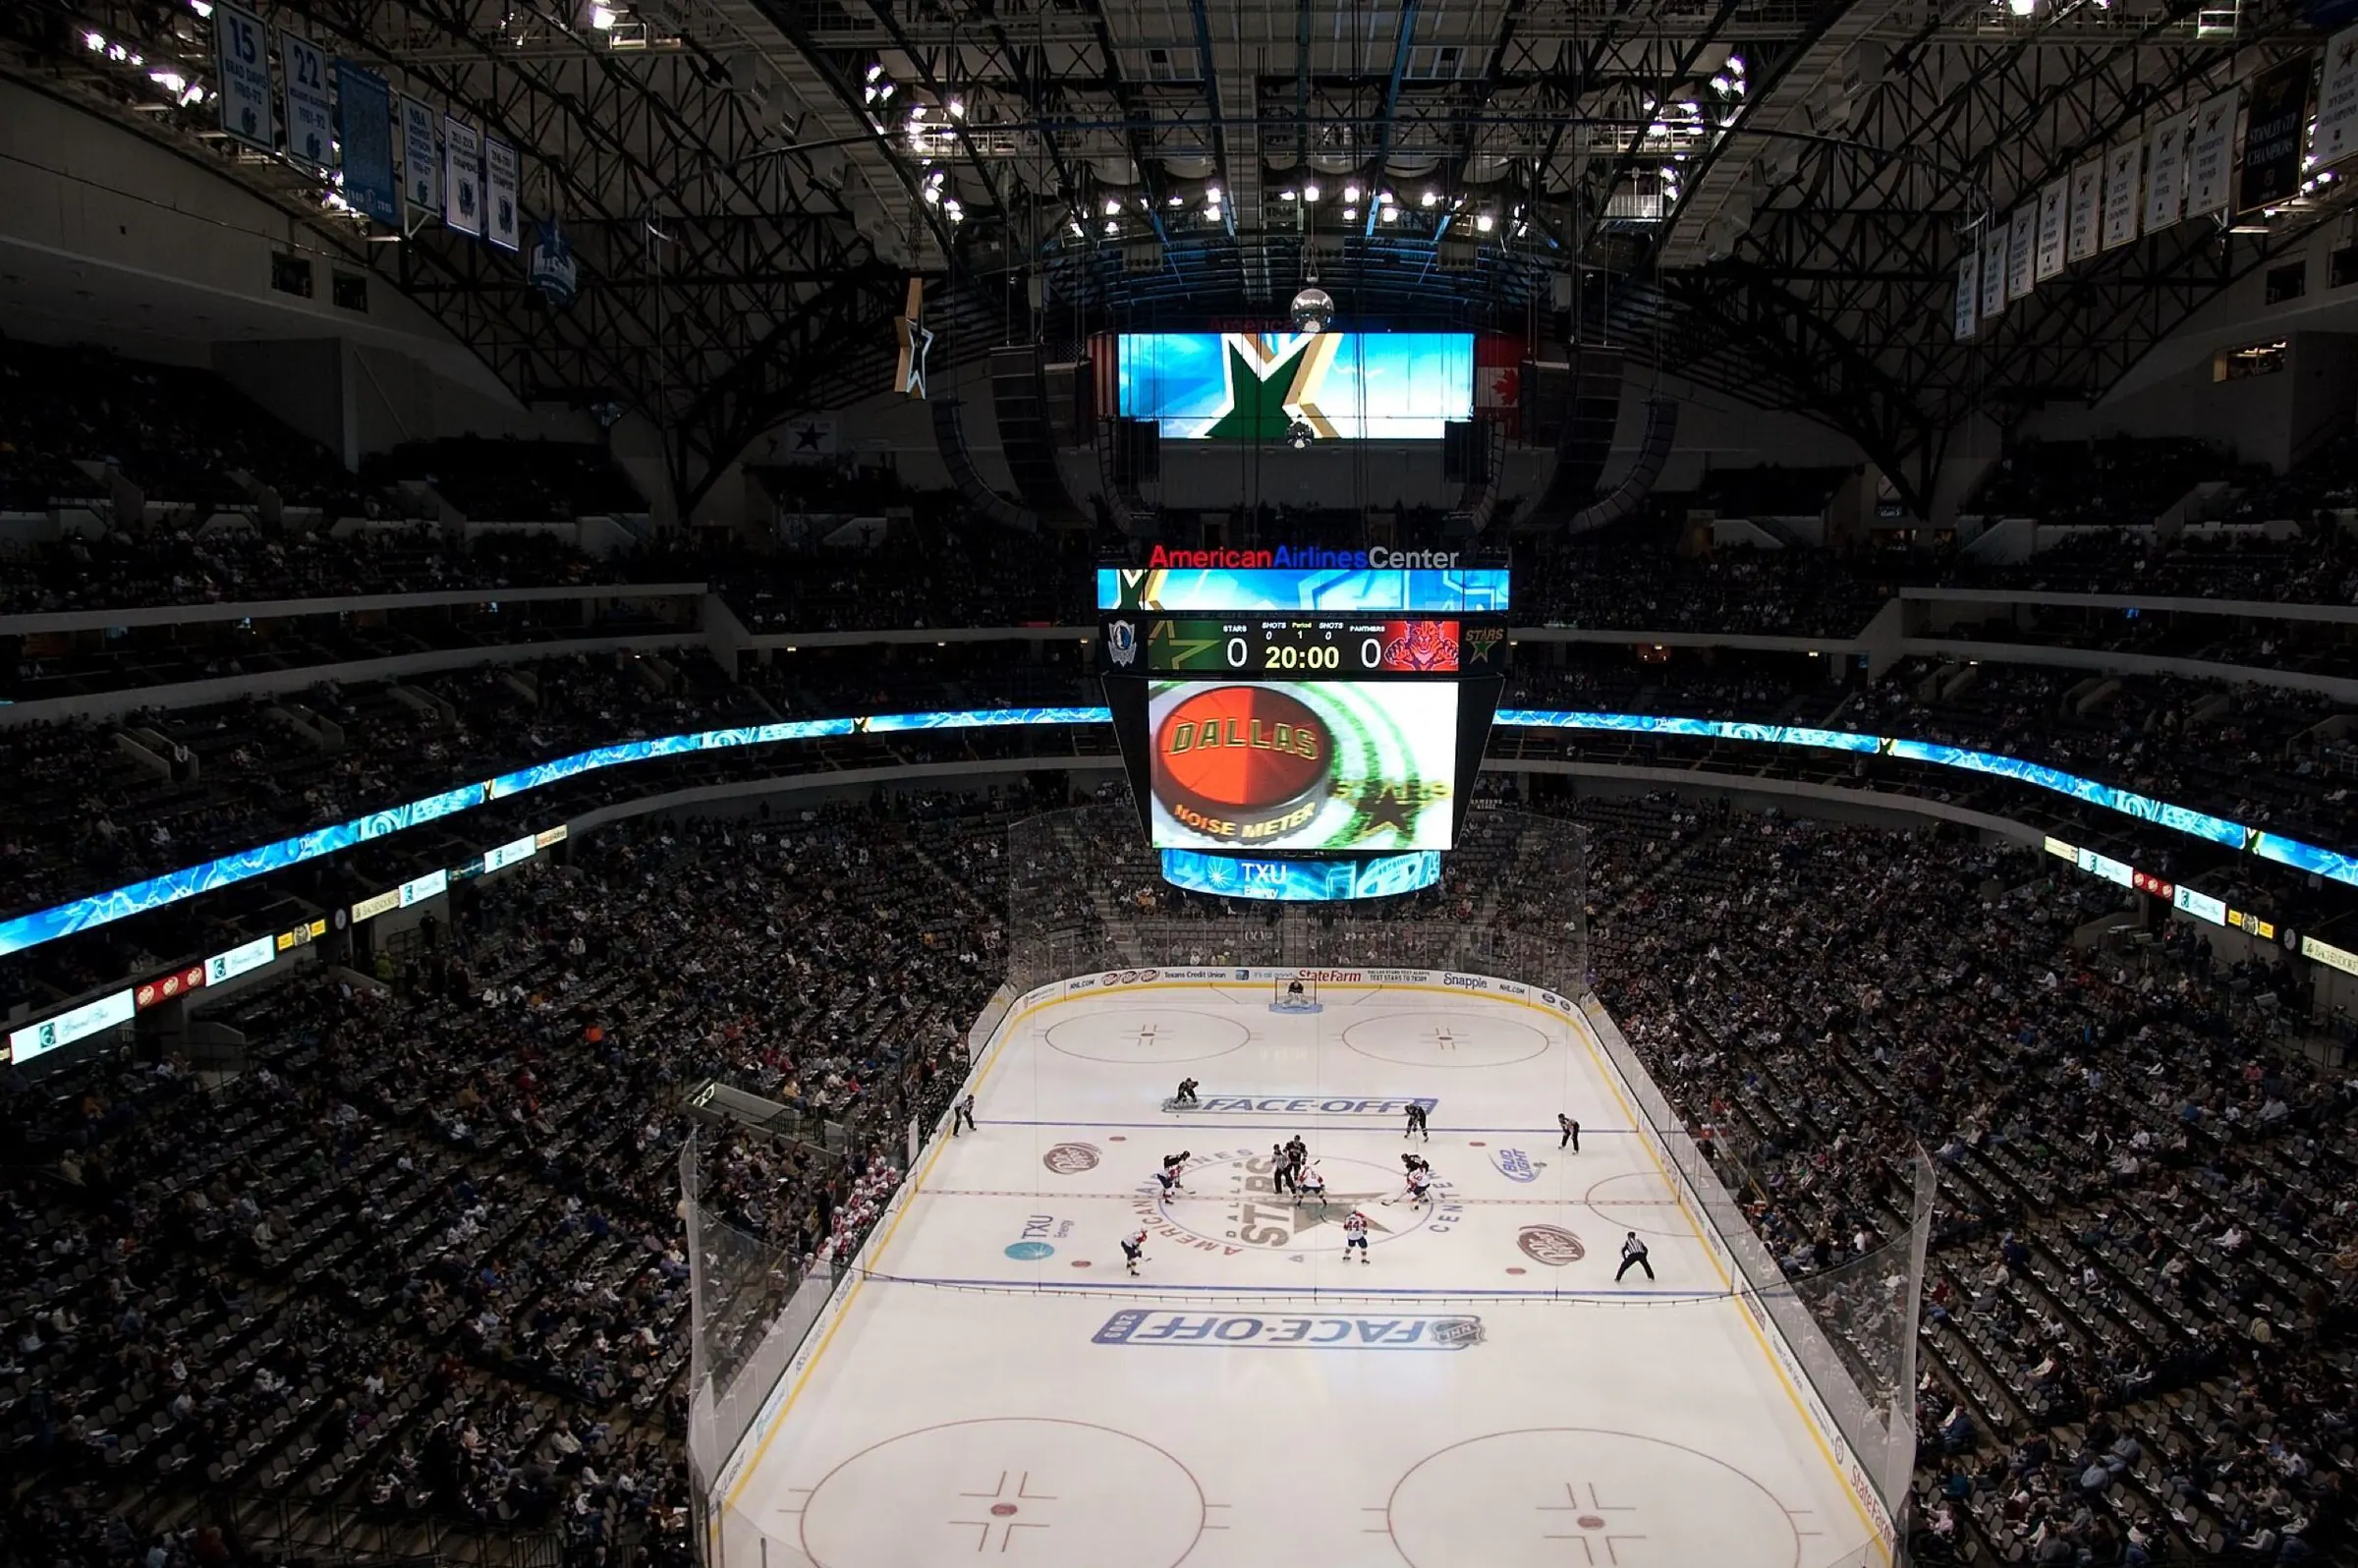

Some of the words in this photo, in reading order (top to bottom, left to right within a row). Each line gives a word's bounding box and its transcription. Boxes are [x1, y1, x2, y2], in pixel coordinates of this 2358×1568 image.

[229, 16, 255, 64] 15
[294, 44, 321, 90] 22
[1265, 631, 1272, 641] 0
[1297, 631, 1303, 640] 1
[1325, 631, 1332, 641] 0
[1319, 621, 1344, 630] SHOTS
[1465, 626, 1504, 642] STARS
[1227, 638, 1248, 668] 0
[1264, 645, 1340, 669] 20:00
[1361, 638, 1381, 669] 0
[1169, 718, 1319, 760] DALLAS
[1174, 804, 1237, 836] NOISE
[1241, 802, 1317, 838] METER
[1241, 863, 1287, 884] TXU
[1186, 970, 1206, 979] Credit
[1443, 972, 1488, 990] Snapple
[1498, 983, 1526, 994] NHL.COM
[1499, 1148, 1519, 1173] BUD
[1512, 1147, 1535, 1178] LIGHT
[1225, 1160, 1244, 1239] DALLAS
[1427, 1168, 1463, 1234] CENTER
[1021, 1214, 1054, 1239] TXU
[1132, 1200, 1244, 1256] AMERICAN
[1346, 1220, 1361, 1232] 44
